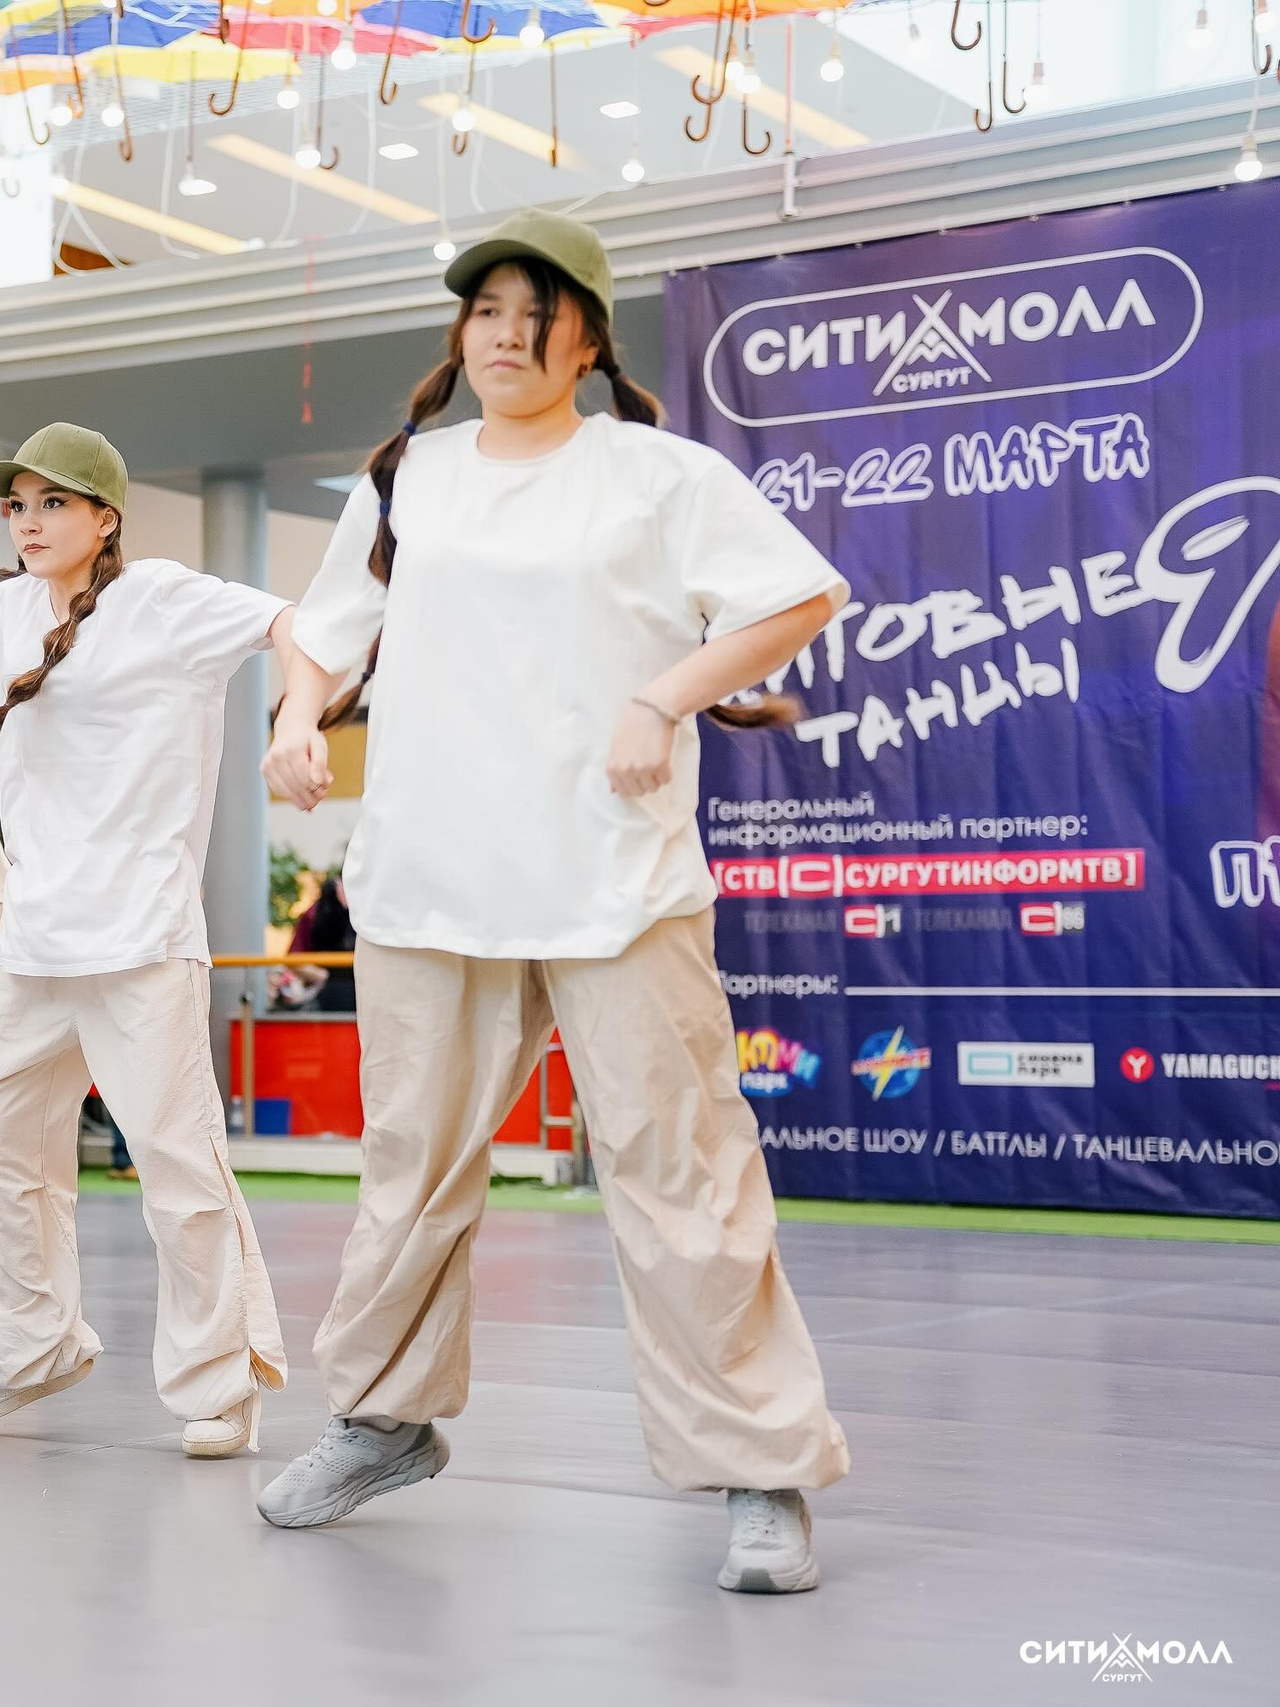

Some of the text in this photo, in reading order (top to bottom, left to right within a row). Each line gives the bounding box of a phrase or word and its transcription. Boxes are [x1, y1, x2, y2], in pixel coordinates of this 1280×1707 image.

[742, 278, 1157, 377] СИТИ МОЛЛ
[890, 365, 972, 395] СУРГУТ
[752, 412, 1151, 512] 21-22 МАРТА
[795, 637, 1081, 769] ТАНЦЫ
[707, 790, 876, 823] Генеральный
[707, 813, 1089, 851] информационный партнер:
[758, 1126, 859, 1152] АЛЬНОЕ
[863, 1127, 928, 1155] ШОУ
[950, 1130, 1047, 1158] БАТТЛЫ
[1071, 1133, 1280, 1166] ТАНЦЕВАЛЬНО
